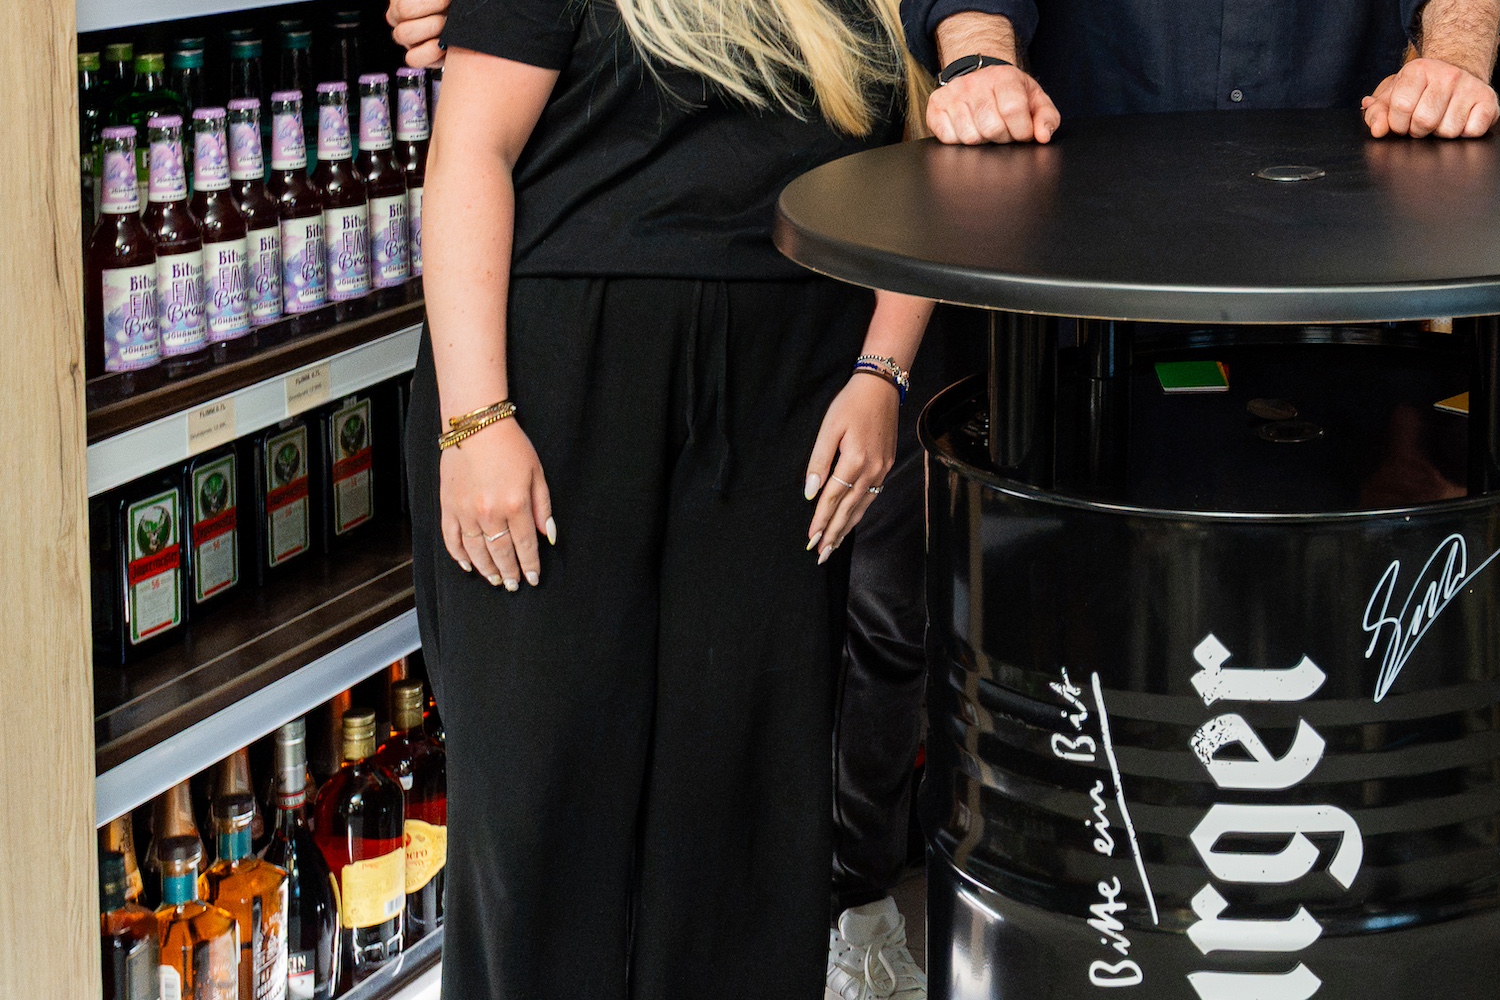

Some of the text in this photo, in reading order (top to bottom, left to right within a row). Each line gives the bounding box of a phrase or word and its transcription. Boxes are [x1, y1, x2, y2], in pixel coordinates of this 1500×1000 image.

[1048, 665, 1144, 988] Bitte ein Bit
